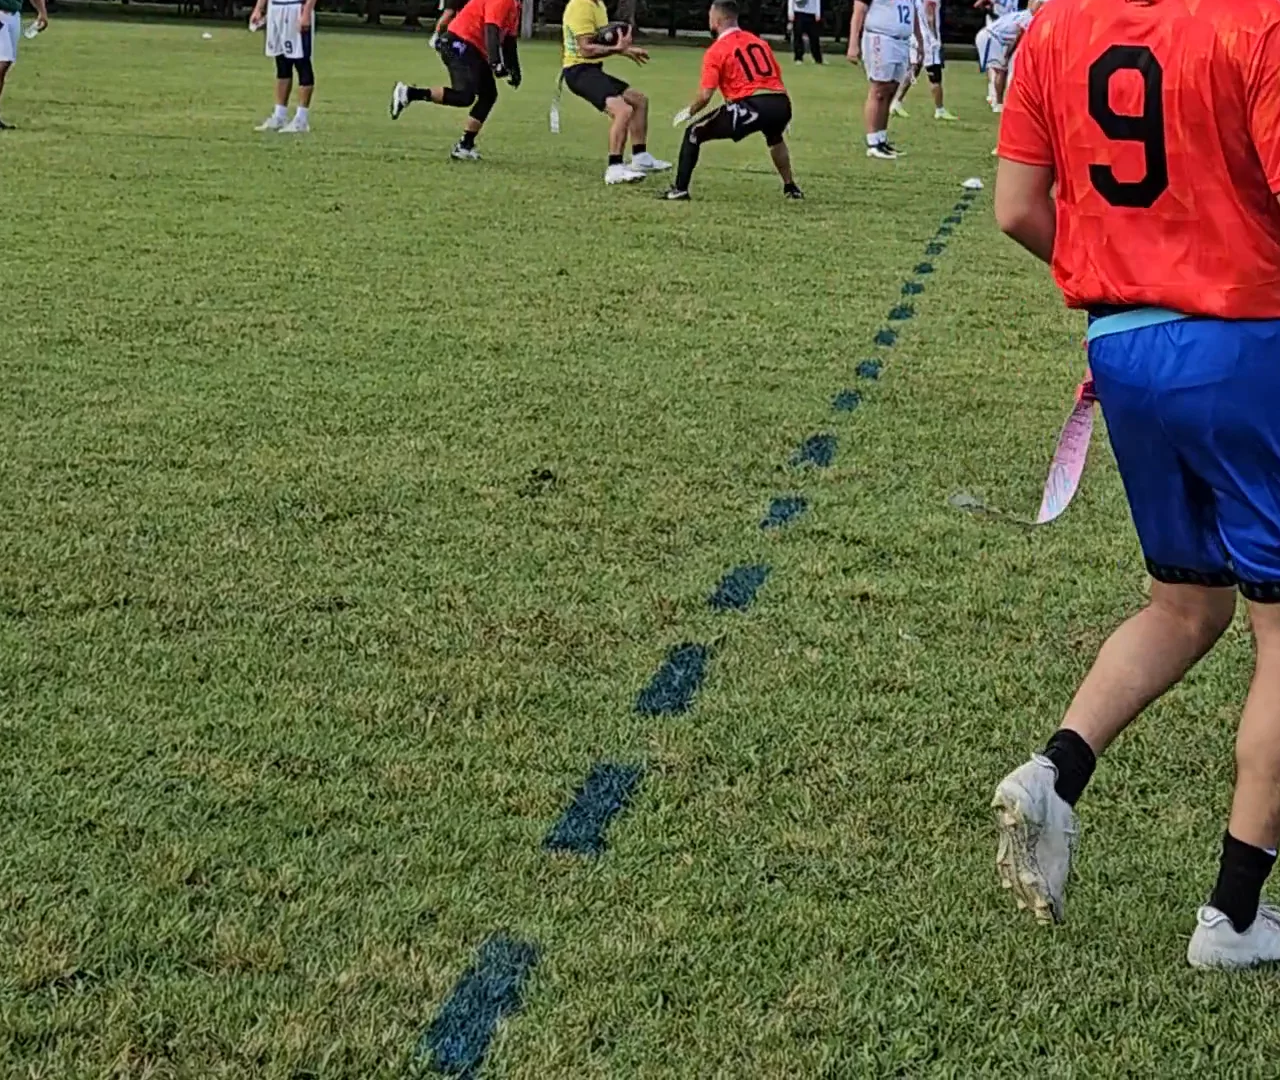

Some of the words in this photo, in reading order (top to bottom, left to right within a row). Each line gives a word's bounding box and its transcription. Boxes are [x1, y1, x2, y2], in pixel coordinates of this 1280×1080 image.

[897, 4, 911, 24] 12
[735, 43, 773, 82] 10
[1088, 44, 1169, 208] 9
